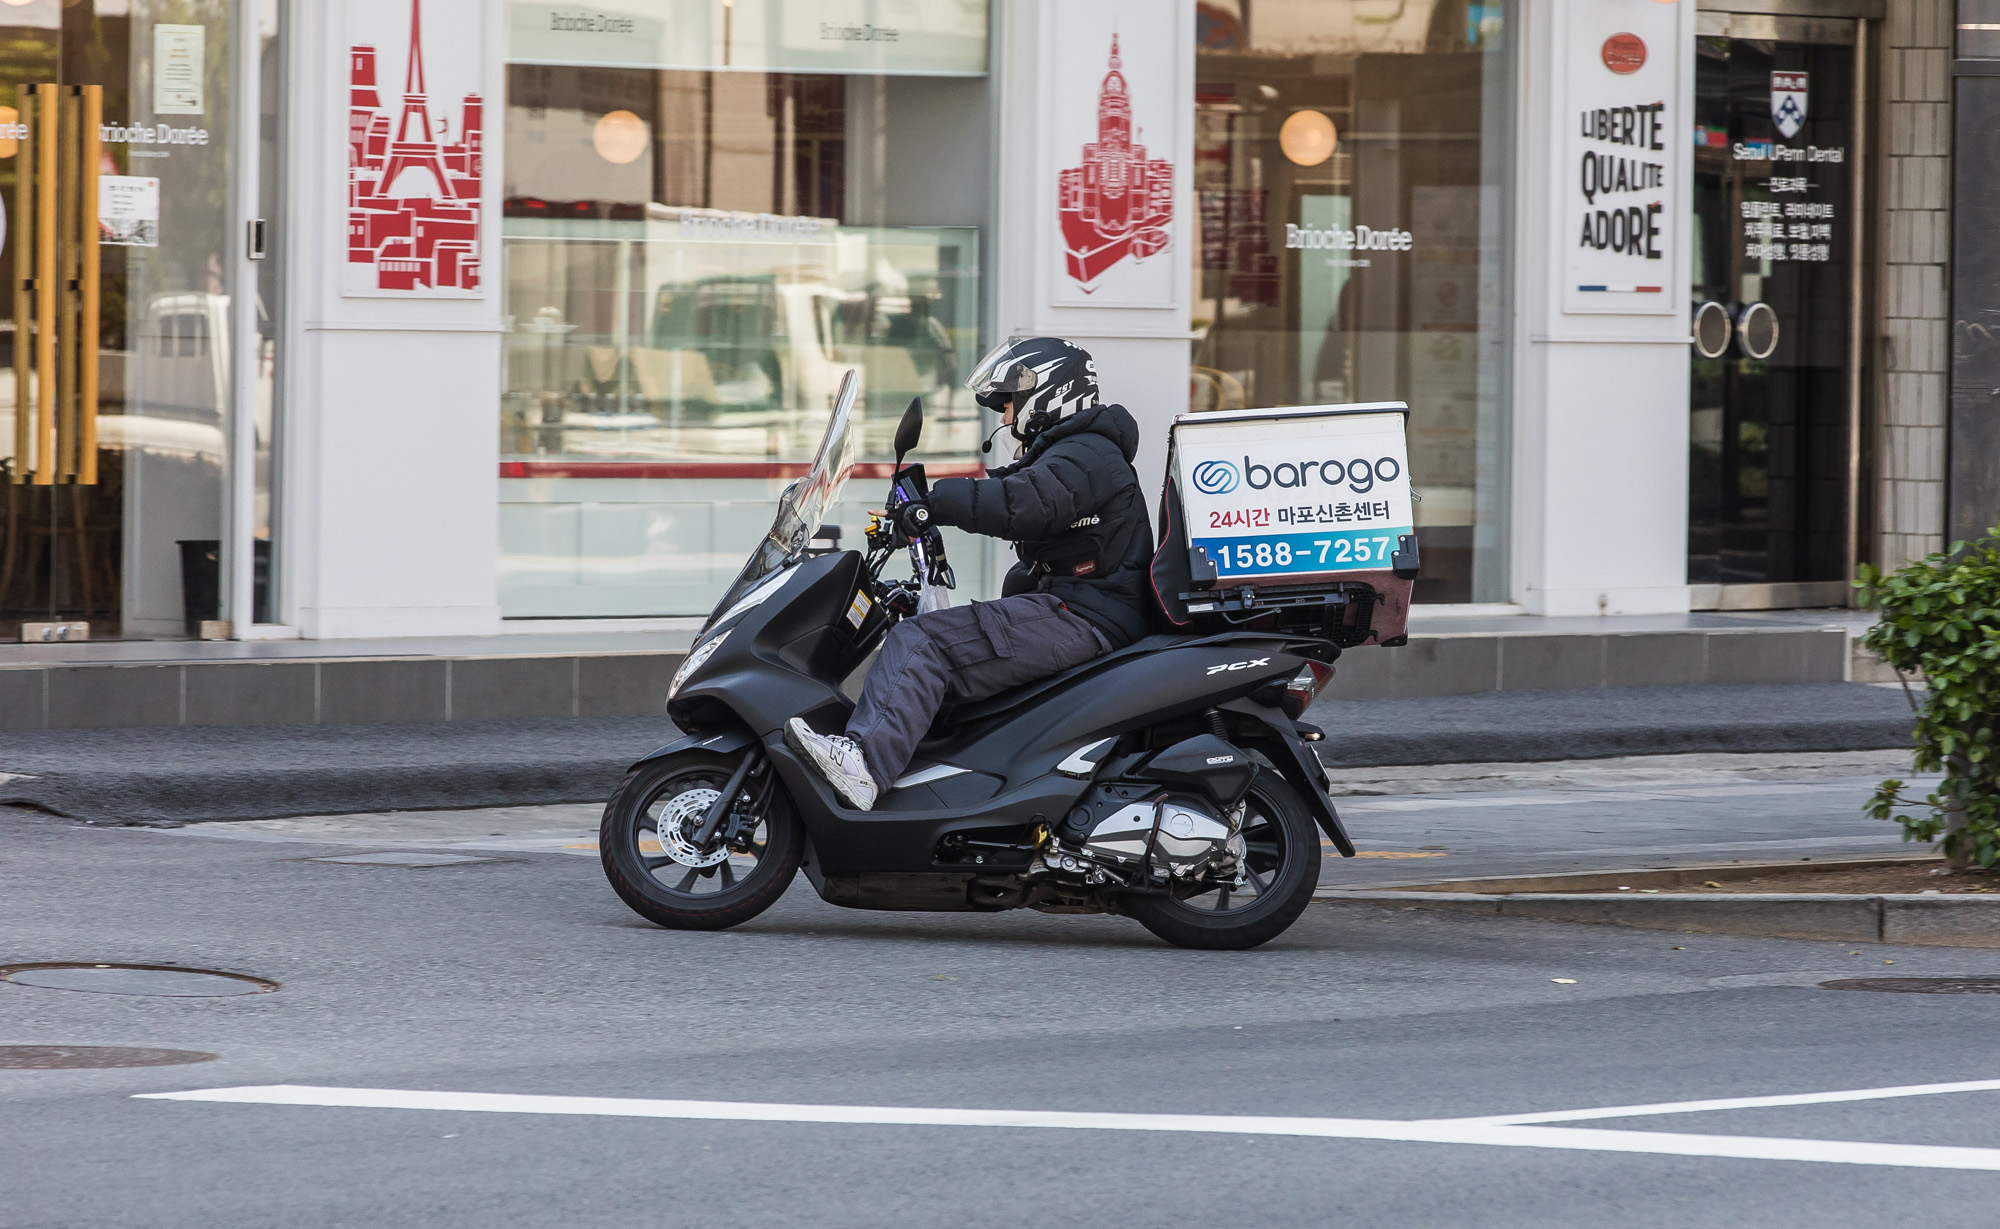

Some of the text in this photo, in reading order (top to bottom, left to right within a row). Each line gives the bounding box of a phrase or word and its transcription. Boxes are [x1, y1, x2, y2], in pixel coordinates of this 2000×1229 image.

[98, 121, 209, 146] rioche Dorée
[1807, 145, 1845, 163] Dental
[1285, 223, 1413, 251] Brioche Dorée
[1244, 455, 1401, 494] barogo
[1209, 500, 1390, 529] 24시간 마포신촌센터
[1217, 536, 1390, 569] 1588-7257
[1206, 657, 1271, 676] PCX
